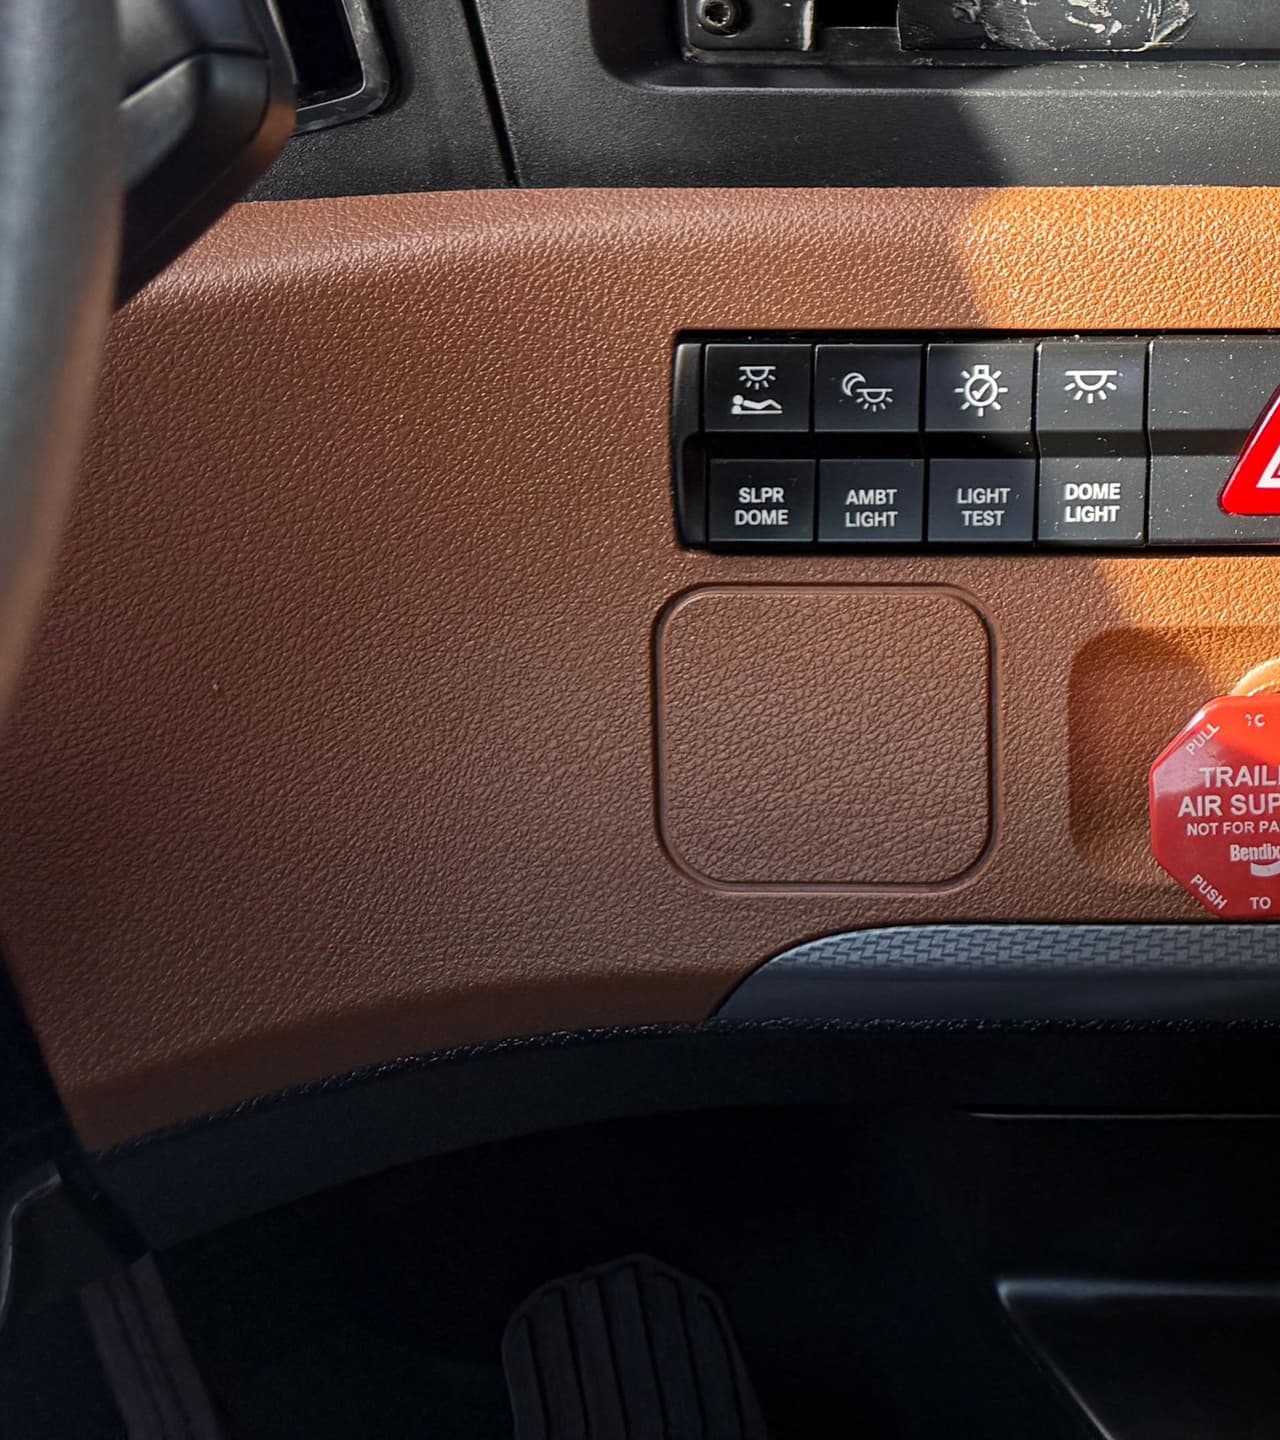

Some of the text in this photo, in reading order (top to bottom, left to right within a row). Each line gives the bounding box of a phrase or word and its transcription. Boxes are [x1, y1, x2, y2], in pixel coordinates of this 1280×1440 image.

[739, 488, 785, 505] SLPR
[846, 490, 897, 506] AMBT
[957, 488, 1011, 505] LIGHT
[1065, 484, 1121, 501] DOME
[734, 510, 789, 527] DOME
[845, 512, 898, 528] LIGHT
[962, 511, 1005, 527] TEST
[1065, 504, 1120, 523] LIGHT
[1186, 723, 1220, 756] PULL
[1178, 795, 1223, 818] AIR
[1187, 823, 1218, 836] NOT
[1223, 821, 1255, 835] FOR
[1191, 874, 1228, 910] PUSH
[1250, 896, 1271, 909] TO
